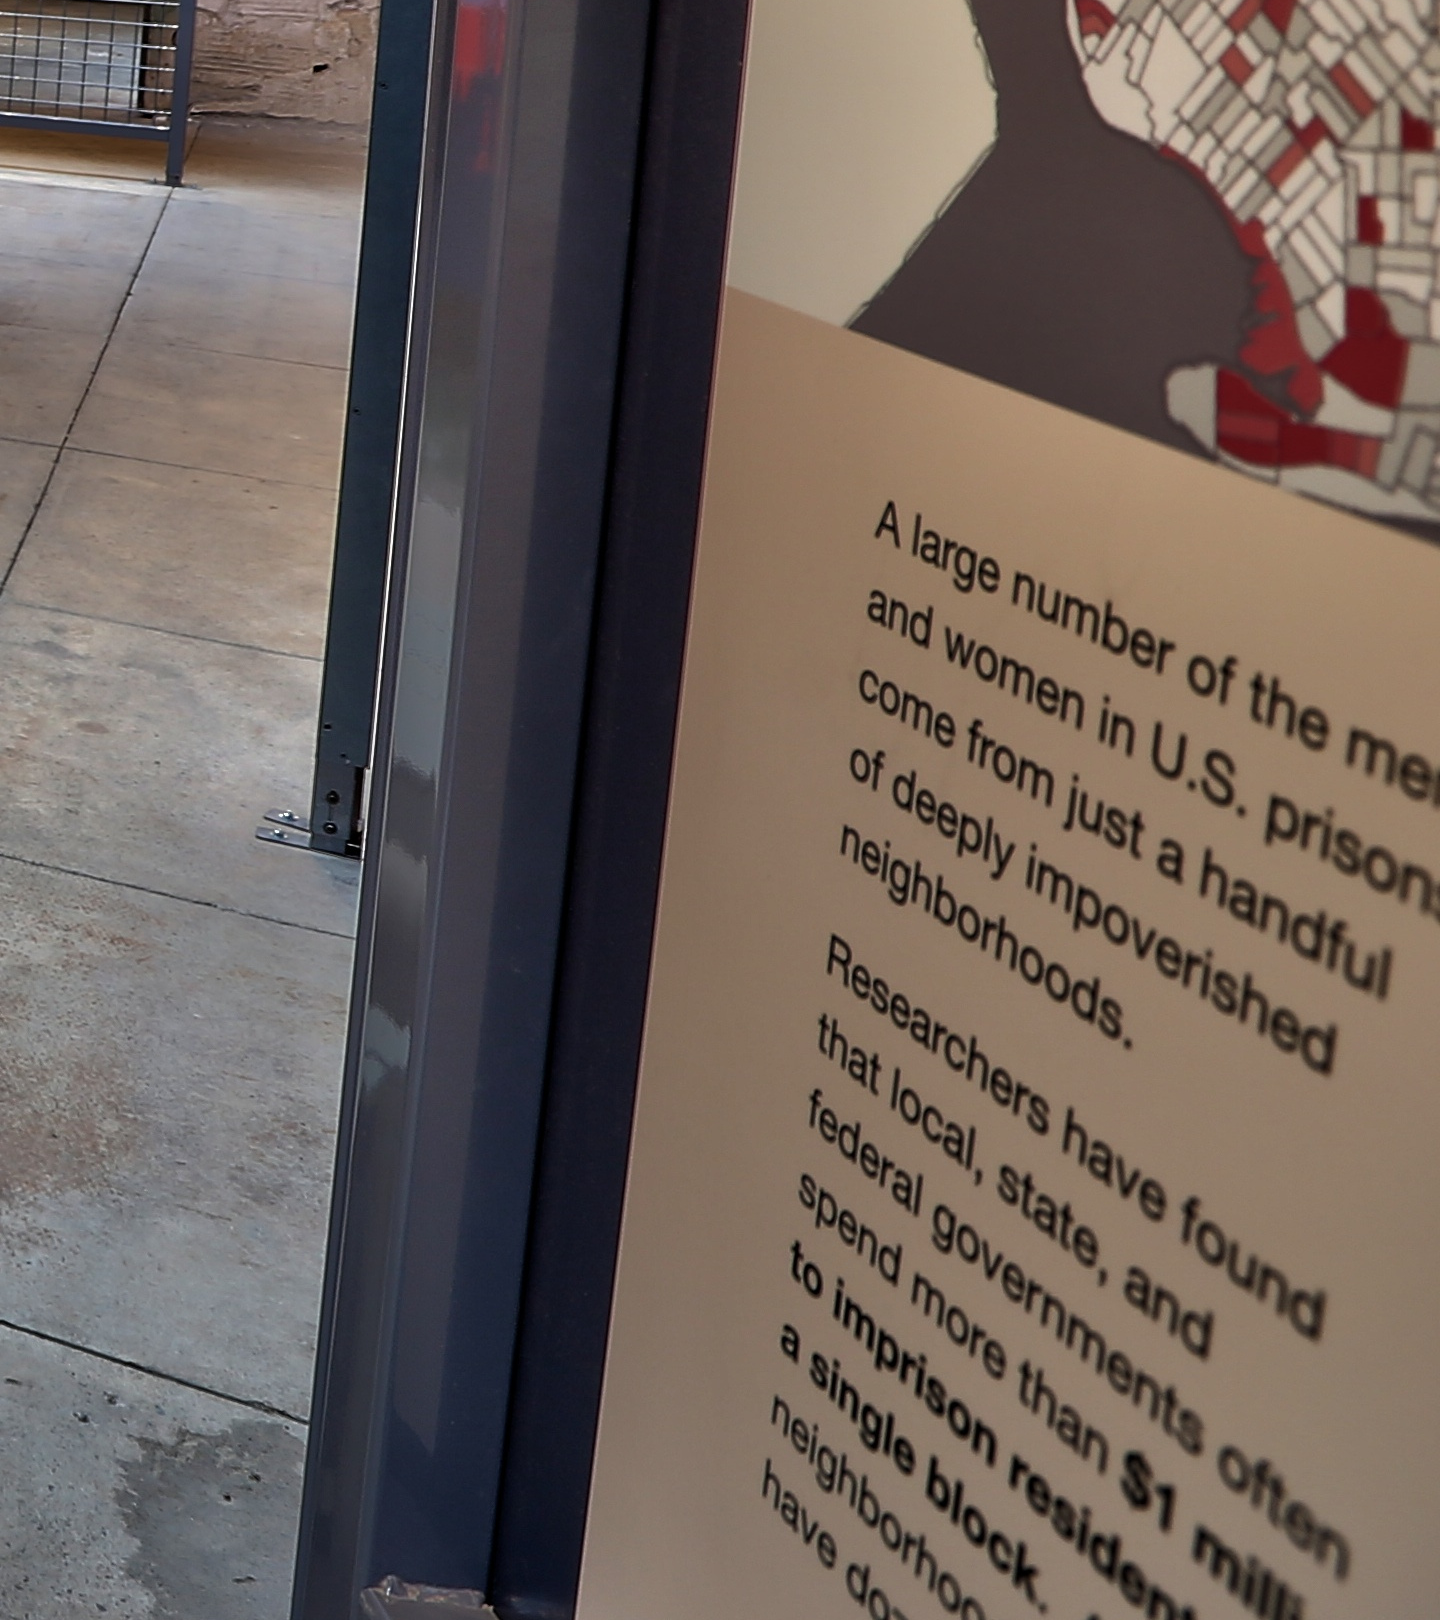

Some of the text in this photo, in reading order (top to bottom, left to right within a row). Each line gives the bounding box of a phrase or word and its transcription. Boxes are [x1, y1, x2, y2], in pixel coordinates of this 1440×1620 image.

[867, 589, 934, 650] and
[944, 626, 1085, 731] women
[1098, 694, 1136, 758] in
[1151, 721, 1246, 817] U.S.
[874, 500, 1440, 808] A large number of the me
[840, 824, 1132, 1050] neighborhoods.
[850, 748, 1338, 1076] of deeply impoverished
[858, 669, 1393, 1000] come from just a handful
[818, 1013, 1216, 1360] that local, state, and
[826, 933, 1329, 1342] Researchers have found
[780, 1324, 800, 1364] a
[810, 1352, 916, 1476] single
[926, 1456, 1046, 1614] block.
[790, 1240, 824, 1298] to
[832, 1278, 998, 1468] imprison
[798, 1174, 902, 1288] spend
[910, 1272, 1006, 1380] more
[1018, 1360, 1108, 1474] than
[1120, 1450, 1176, 1532] $1
[809, 1088, 1352, 1583] federal governments often
[762, 1458, 838, 1570] have
